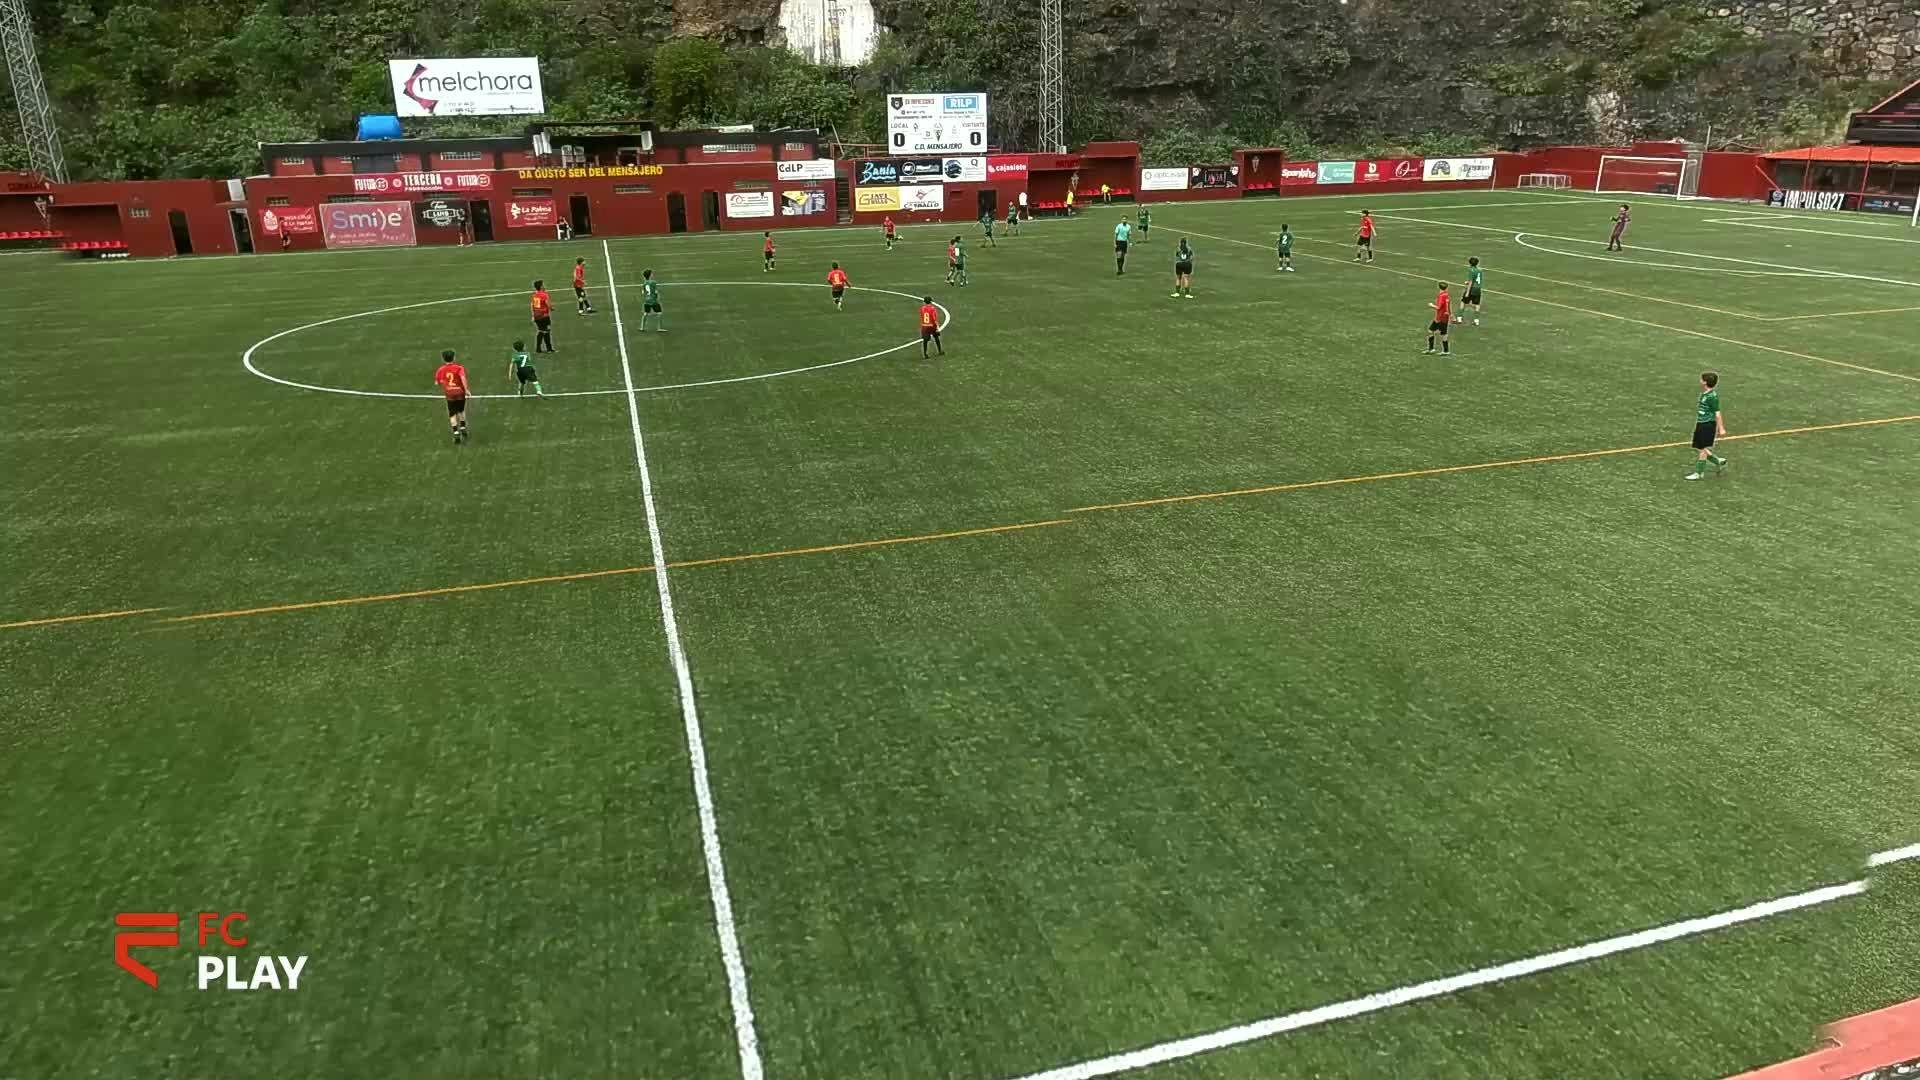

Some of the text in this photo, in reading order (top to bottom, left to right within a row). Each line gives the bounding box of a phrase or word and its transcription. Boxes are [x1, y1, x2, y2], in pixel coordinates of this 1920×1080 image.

[418, 71, 532, 92] melchora
[950, 99, 972, 108] RILP
[894, 132, 906, 147] 0
[970, 132, 982, 146] 0
[518, 165, 664, 178] DA GUSTO SER DEL MENSAJERO
[778, 164, 804, 172] CdLP
[403, 174, 442, 186] TERCERA
[1476, 273, 1480, 284] 4
[645, 284, 651, 296] 9
[520, 354, 528, 367] 7
[446, 372, 456, 386] 2
